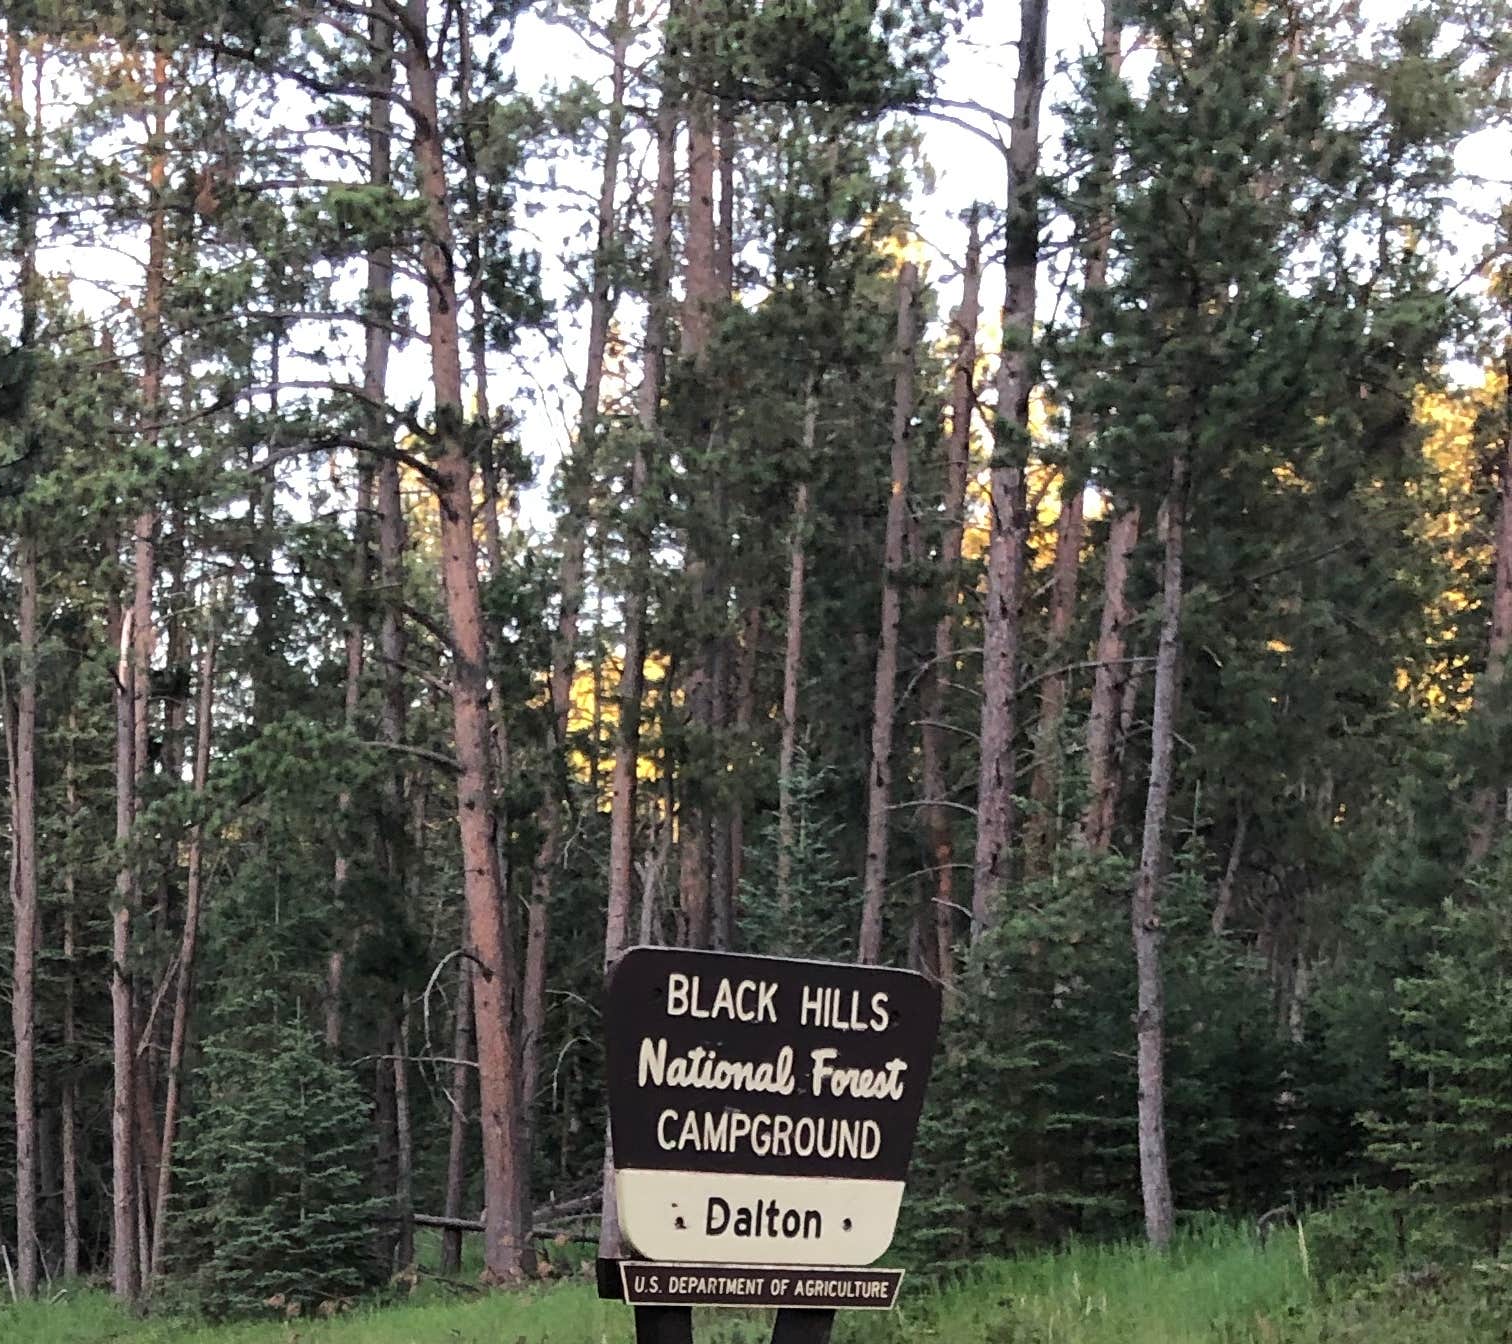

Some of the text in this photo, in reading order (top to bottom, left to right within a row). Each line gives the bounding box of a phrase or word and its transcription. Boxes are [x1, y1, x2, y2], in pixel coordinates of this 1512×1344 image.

[666, 973, 889, 1032] BLACK HILLS
[638, 1037, 908, 1101] National Forest
[656, 1108, 881, 1160] CAMPGROUND
[705, 1196, 823, 1239] Dalton
[633, 1275, 889, 1299] U.S. DEPARTMENT OF AGRICULTURE
